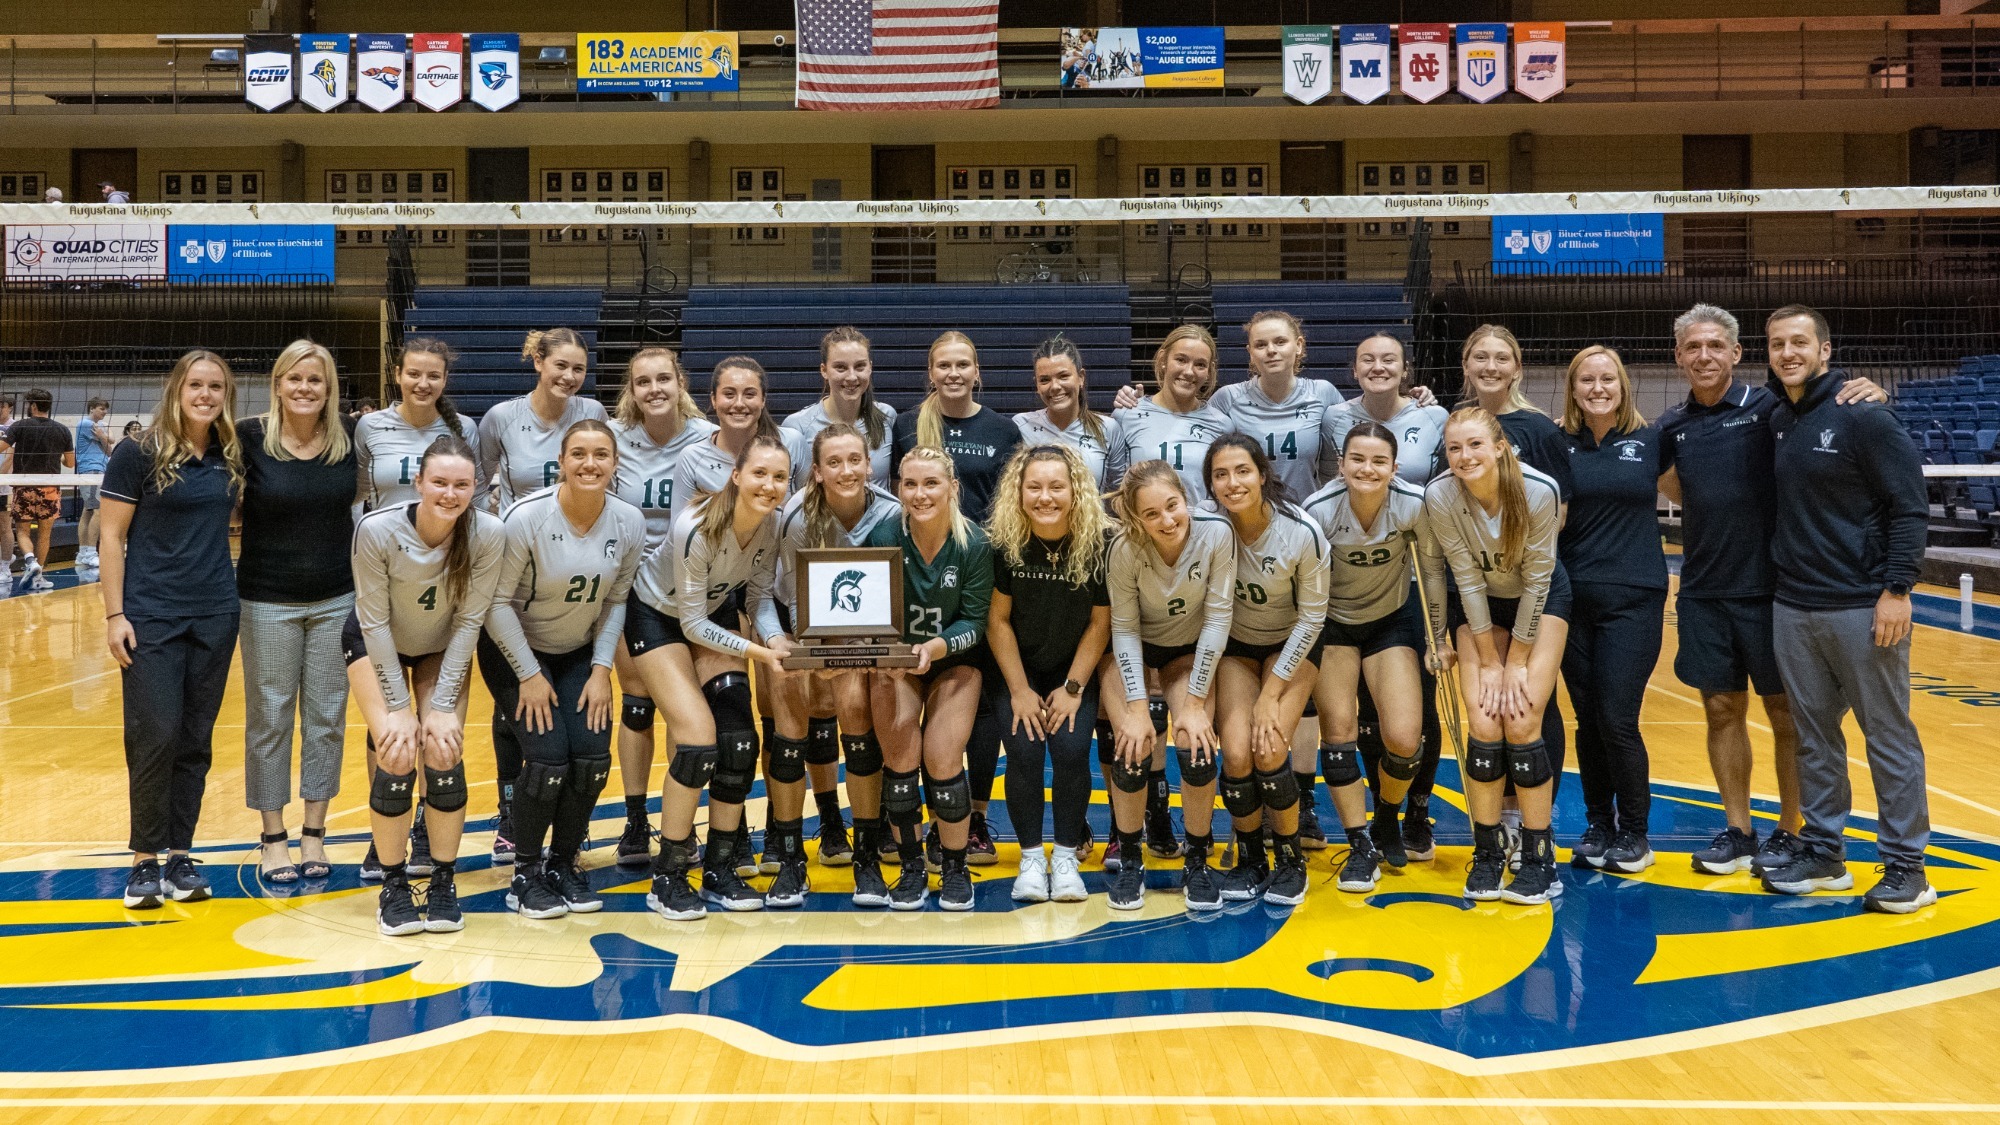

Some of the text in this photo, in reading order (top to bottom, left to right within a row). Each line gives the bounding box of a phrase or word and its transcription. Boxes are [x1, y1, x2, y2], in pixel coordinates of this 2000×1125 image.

[1145, 35, 1177, 45] $2,000
[586, 39, 703, 59] 183 ACADEMIC
[589, 61, 703, 73] ALL-AMERICANS
[1159, 56, 1184, 64] AUGIE
[1185, 56, 1217, 64] CHOICE
[1349, 59, 1381, 77] M
[247, 69, 290, 82] CCIW
[586, 79, 597, 87] #1
[661, 79, 672, 87] 12
[1653, 192, 1760, 207] Augustana Vikings
[1928, 189, 1987, 202] Augustana
[595, 204, 697, 218] Augustana Vikings
[856, 203, 959, 216] Augustana Vikings
[1119, 199, 1223, 213] Augustana Vikings
[1385, 197, 1489, 211] Augustana Vikings
[69, 205, 172, 218] Augustana Vikings
[332, 205, 435, 218] Augustana Vikings
[53, 240, 159, 254] QUAD CITIES
[232, 239, 323, 247] BlueCross BlueShield
[1558, 240, 1599, 248] of Illinois
[121, 255, 158, 263] AIRPORT
[232, 250, 272, 258] of Illinois
[945, 447, 982, 456] EYBALL
[949, 441, 983, 449] WESLEYAN
[1265, 431, 1297, 460] 14
[1159, 442, 1184, 471] 11
[642, 478, 673, 509] 18
[1347, 548, 1391, 567] 22
[564, 573, 601, 603] 21
[1234, 579, 1268, 605] 20
[417, 585, 437, 611] 4
[1167, 599, 1187, 616] 2
[909, 604, 943, 637] 23
[1527, 595, 1545, 637] FIGHTIN
[702, 628, 740, 651] TITANS
[1118, 651, 1138, 694] TITANS
[374, 663, 396, 705] TITANS
